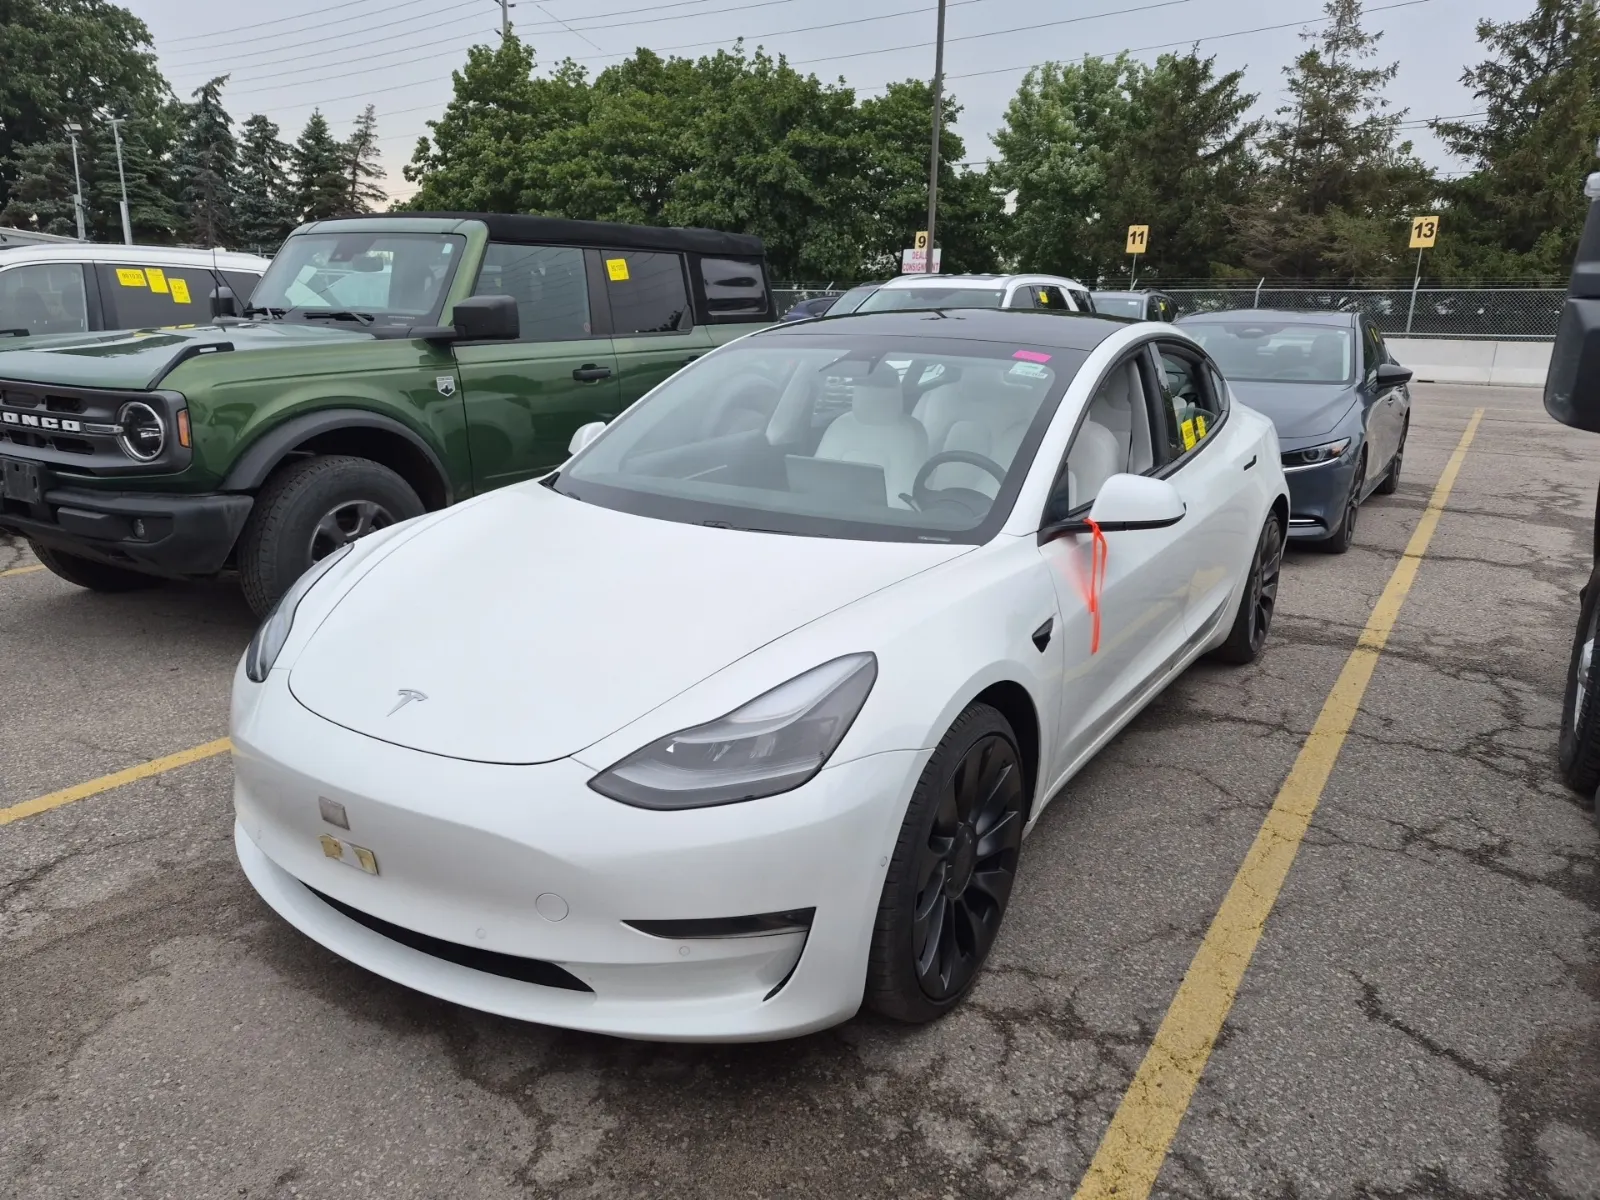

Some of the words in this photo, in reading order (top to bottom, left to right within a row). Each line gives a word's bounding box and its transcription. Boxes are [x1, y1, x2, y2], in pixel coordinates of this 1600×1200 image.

[1414, 222, 1435, 238] 13
[918, 235, 927, 248] 9
[1130, 231, 1145, 245] 11
[911, 251, 928, 260] DEAL
[903, 262, 940, 271] CONSIGNNT
[0, 411, 81, 432] ONCO
